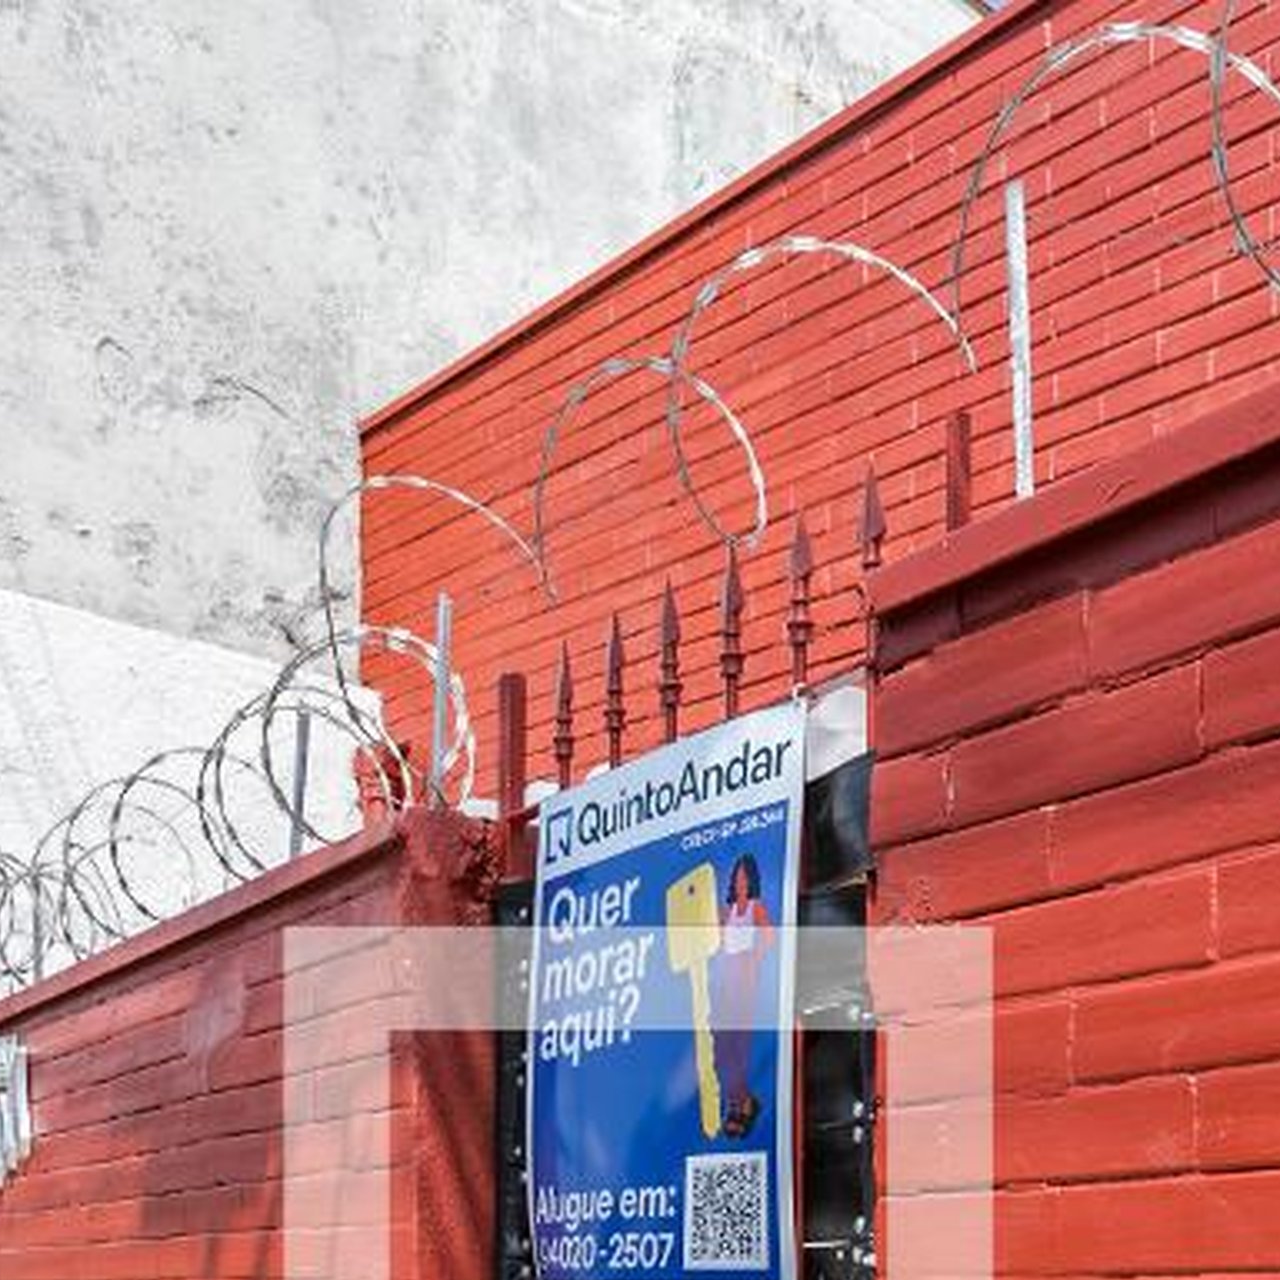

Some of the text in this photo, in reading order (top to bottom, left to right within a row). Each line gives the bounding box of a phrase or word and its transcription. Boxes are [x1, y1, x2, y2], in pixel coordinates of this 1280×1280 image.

[577, 740, 792, 847] QuintoAndar
[549, 876, 641, 943] Quer
[543, 933, 655, 1001] morar
[540, 984, 639, 1067] aqui?
[536, 1186, 676, 1231] Alugue em:
